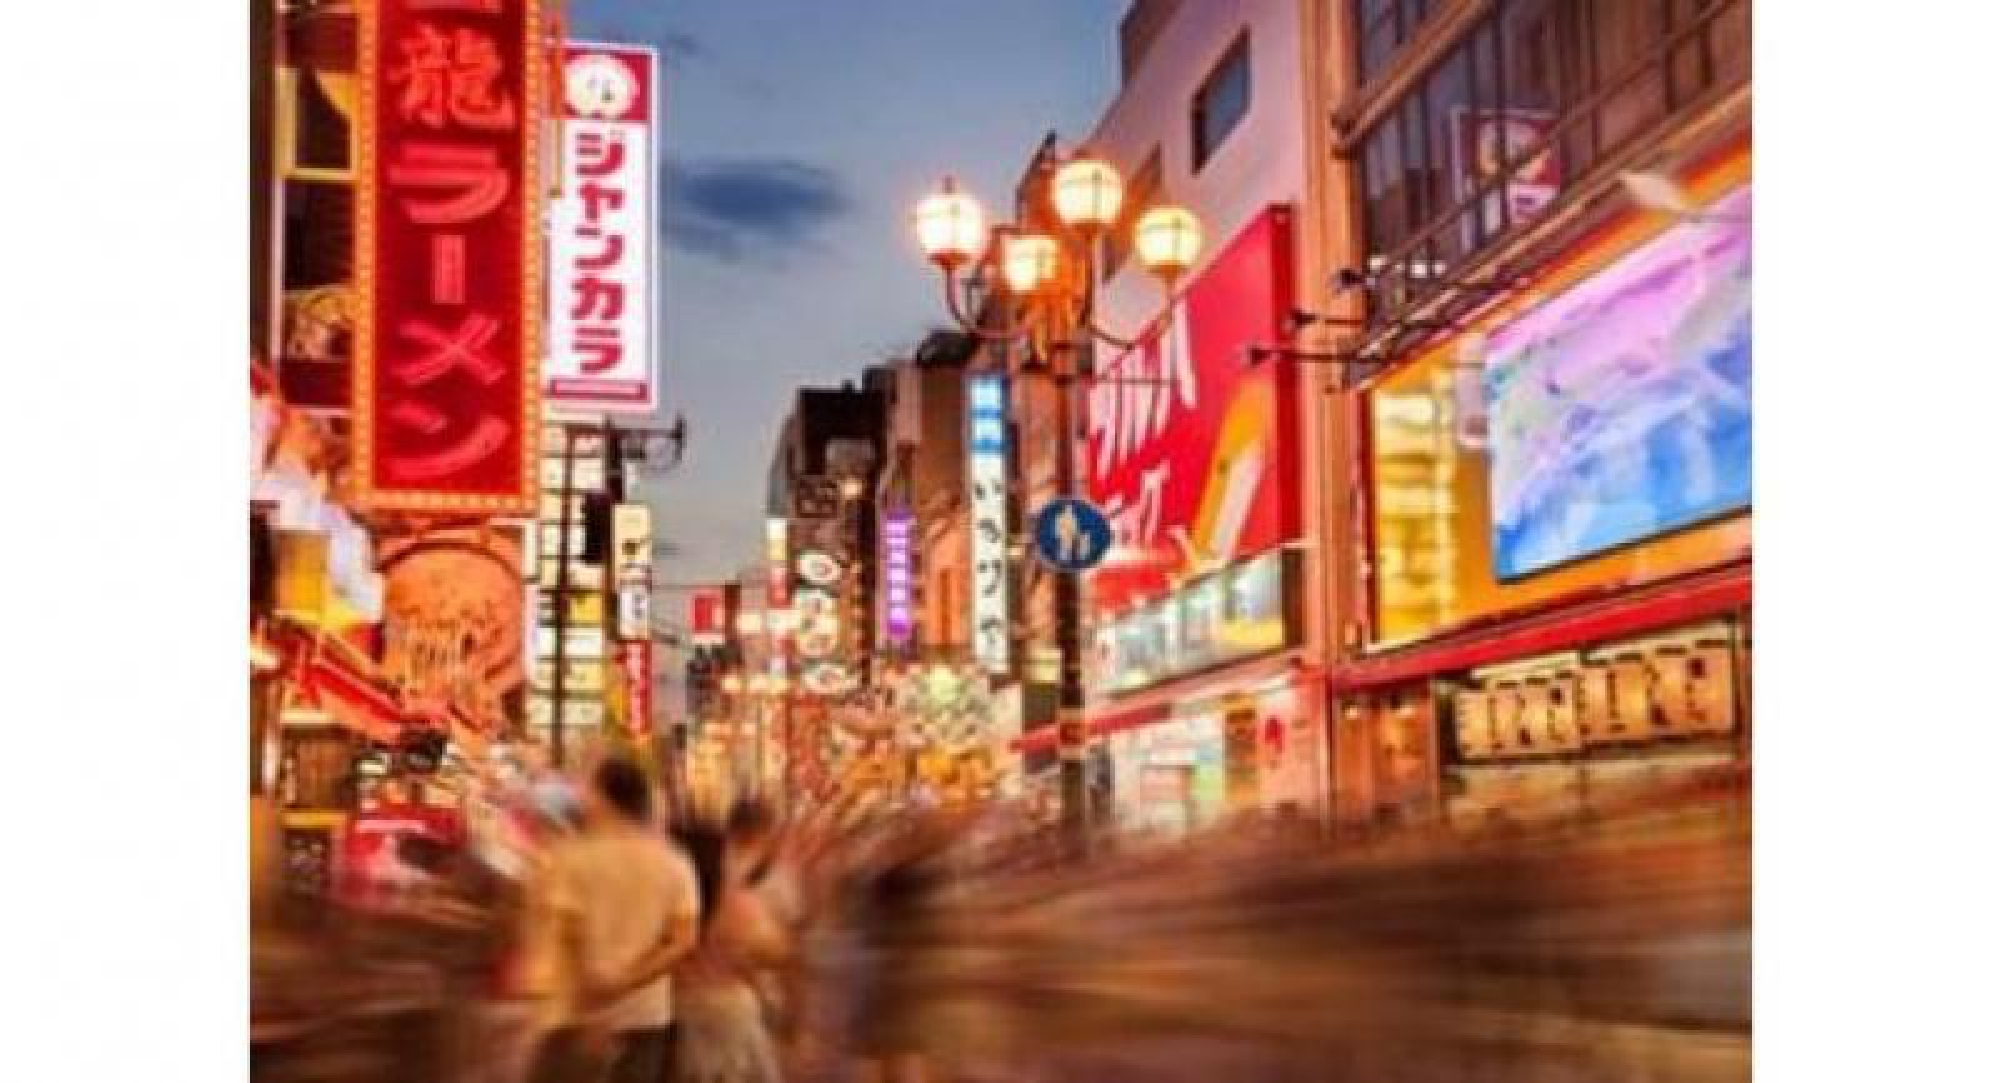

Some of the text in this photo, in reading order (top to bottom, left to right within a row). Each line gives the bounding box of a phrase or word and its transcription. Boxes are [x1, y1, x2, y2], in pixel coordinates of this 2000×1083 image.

[386, 0, 516, 480] 龍ラーメン
[570, 129, 626, 374] ジャンカラ
